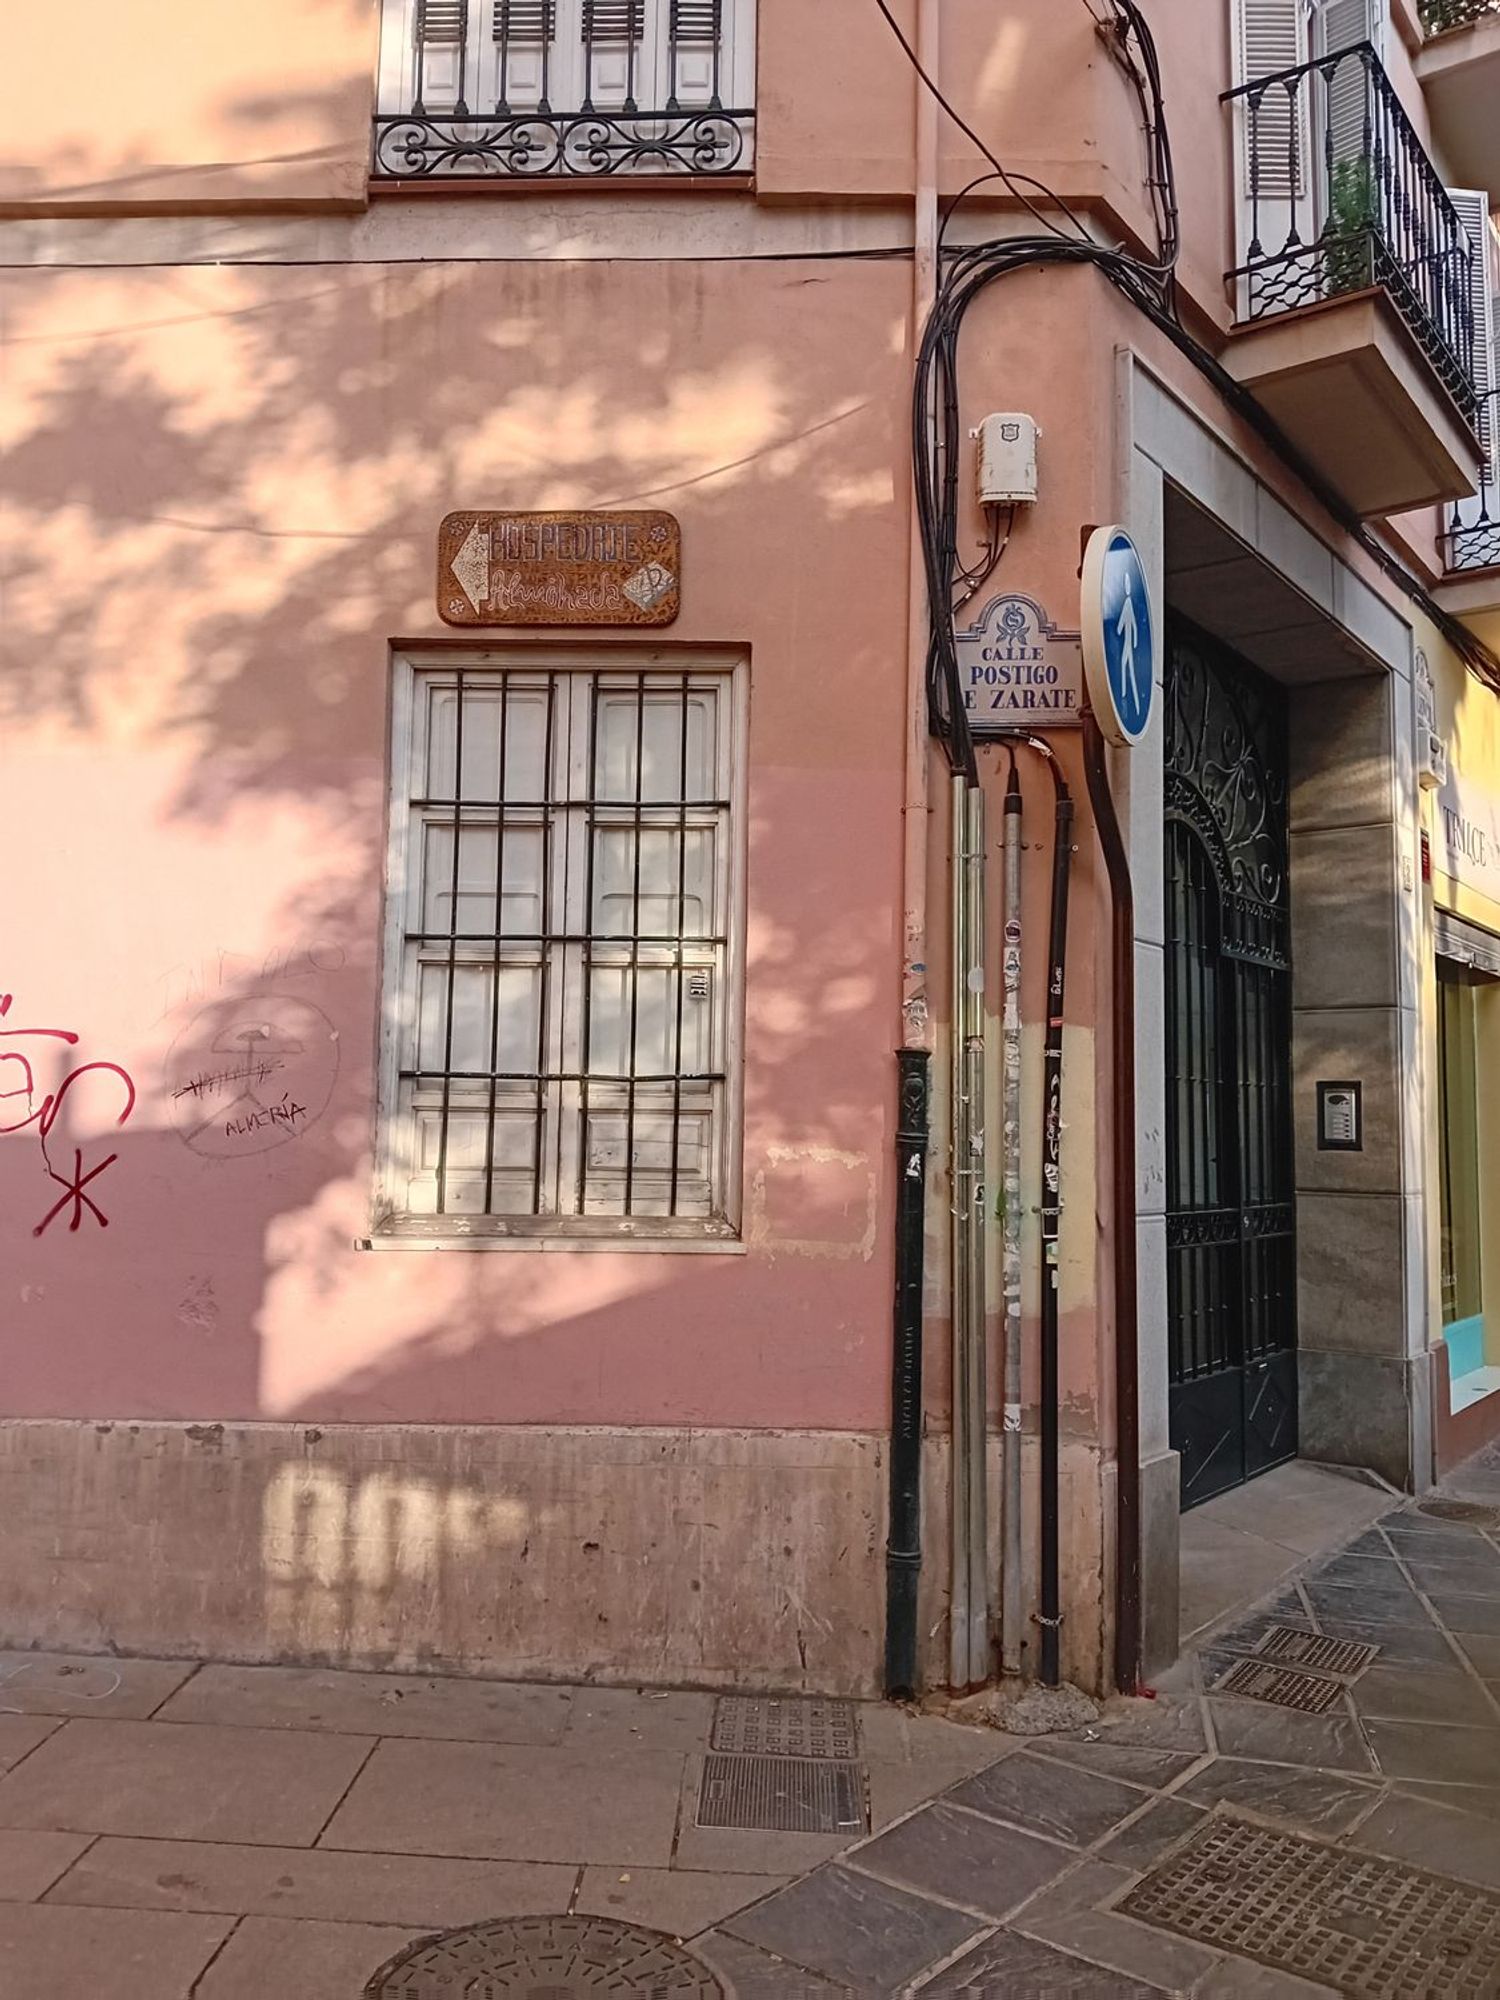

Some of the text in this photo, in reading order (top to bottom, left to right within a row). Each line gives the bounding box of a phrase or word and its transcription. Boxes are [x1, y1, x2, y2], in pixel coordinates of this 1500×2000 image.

[489, 523, 641, 563] HOSPEDAJE
[982, 647, 1044, 661] CALLE
[971, 665, 1058, 685] POSTIGO
[964, 689, 1076, 709] E ZARATE
